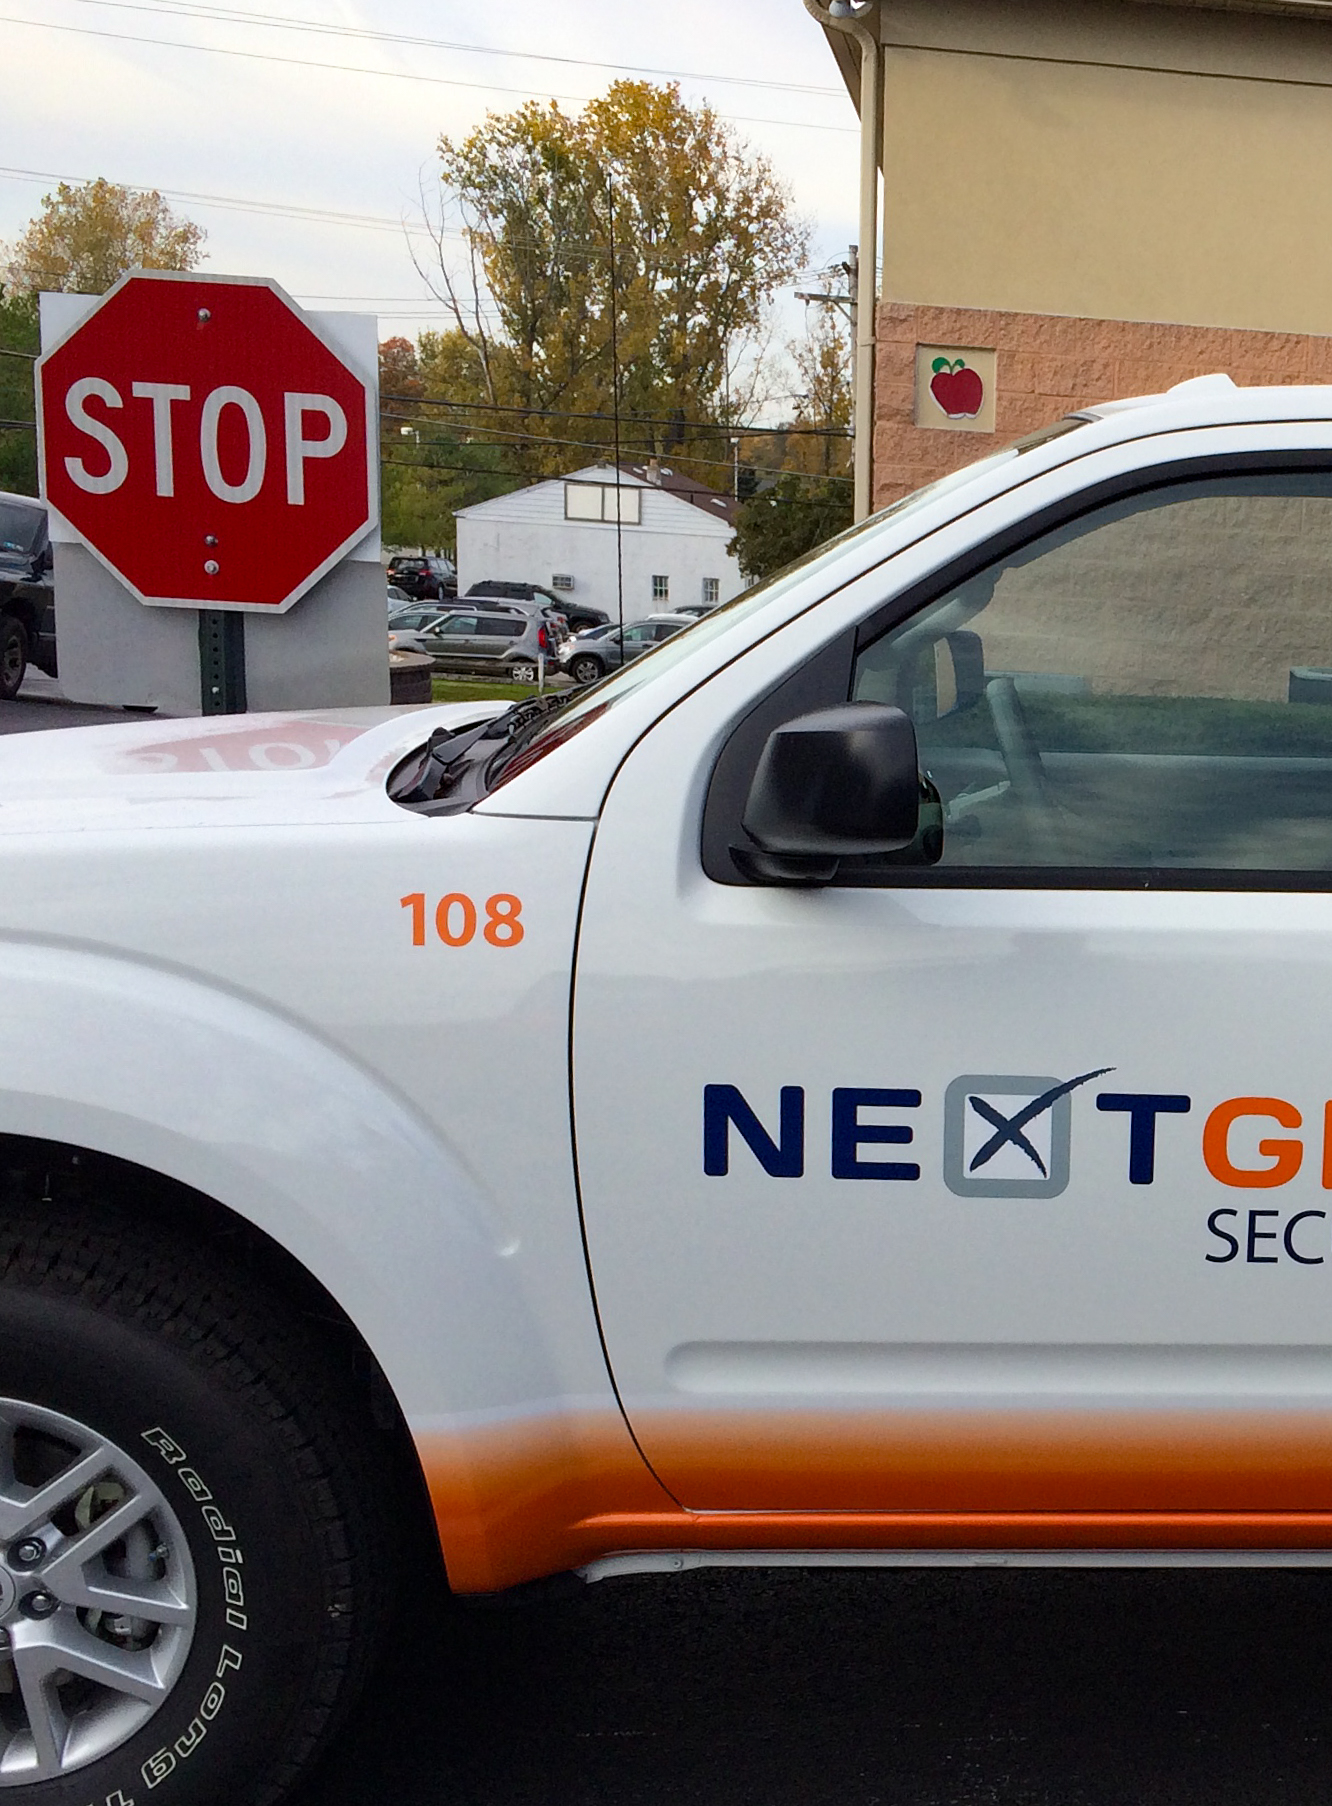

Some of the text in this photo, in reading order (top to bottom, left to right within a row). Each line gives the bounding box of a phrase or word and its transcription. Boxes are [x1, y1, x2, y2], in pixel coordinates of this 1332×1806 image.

[64, 376, 348, 506] STOP
[399, 892, 525, 948] 108
[141, 1427, 247, 1789] Radial Long
